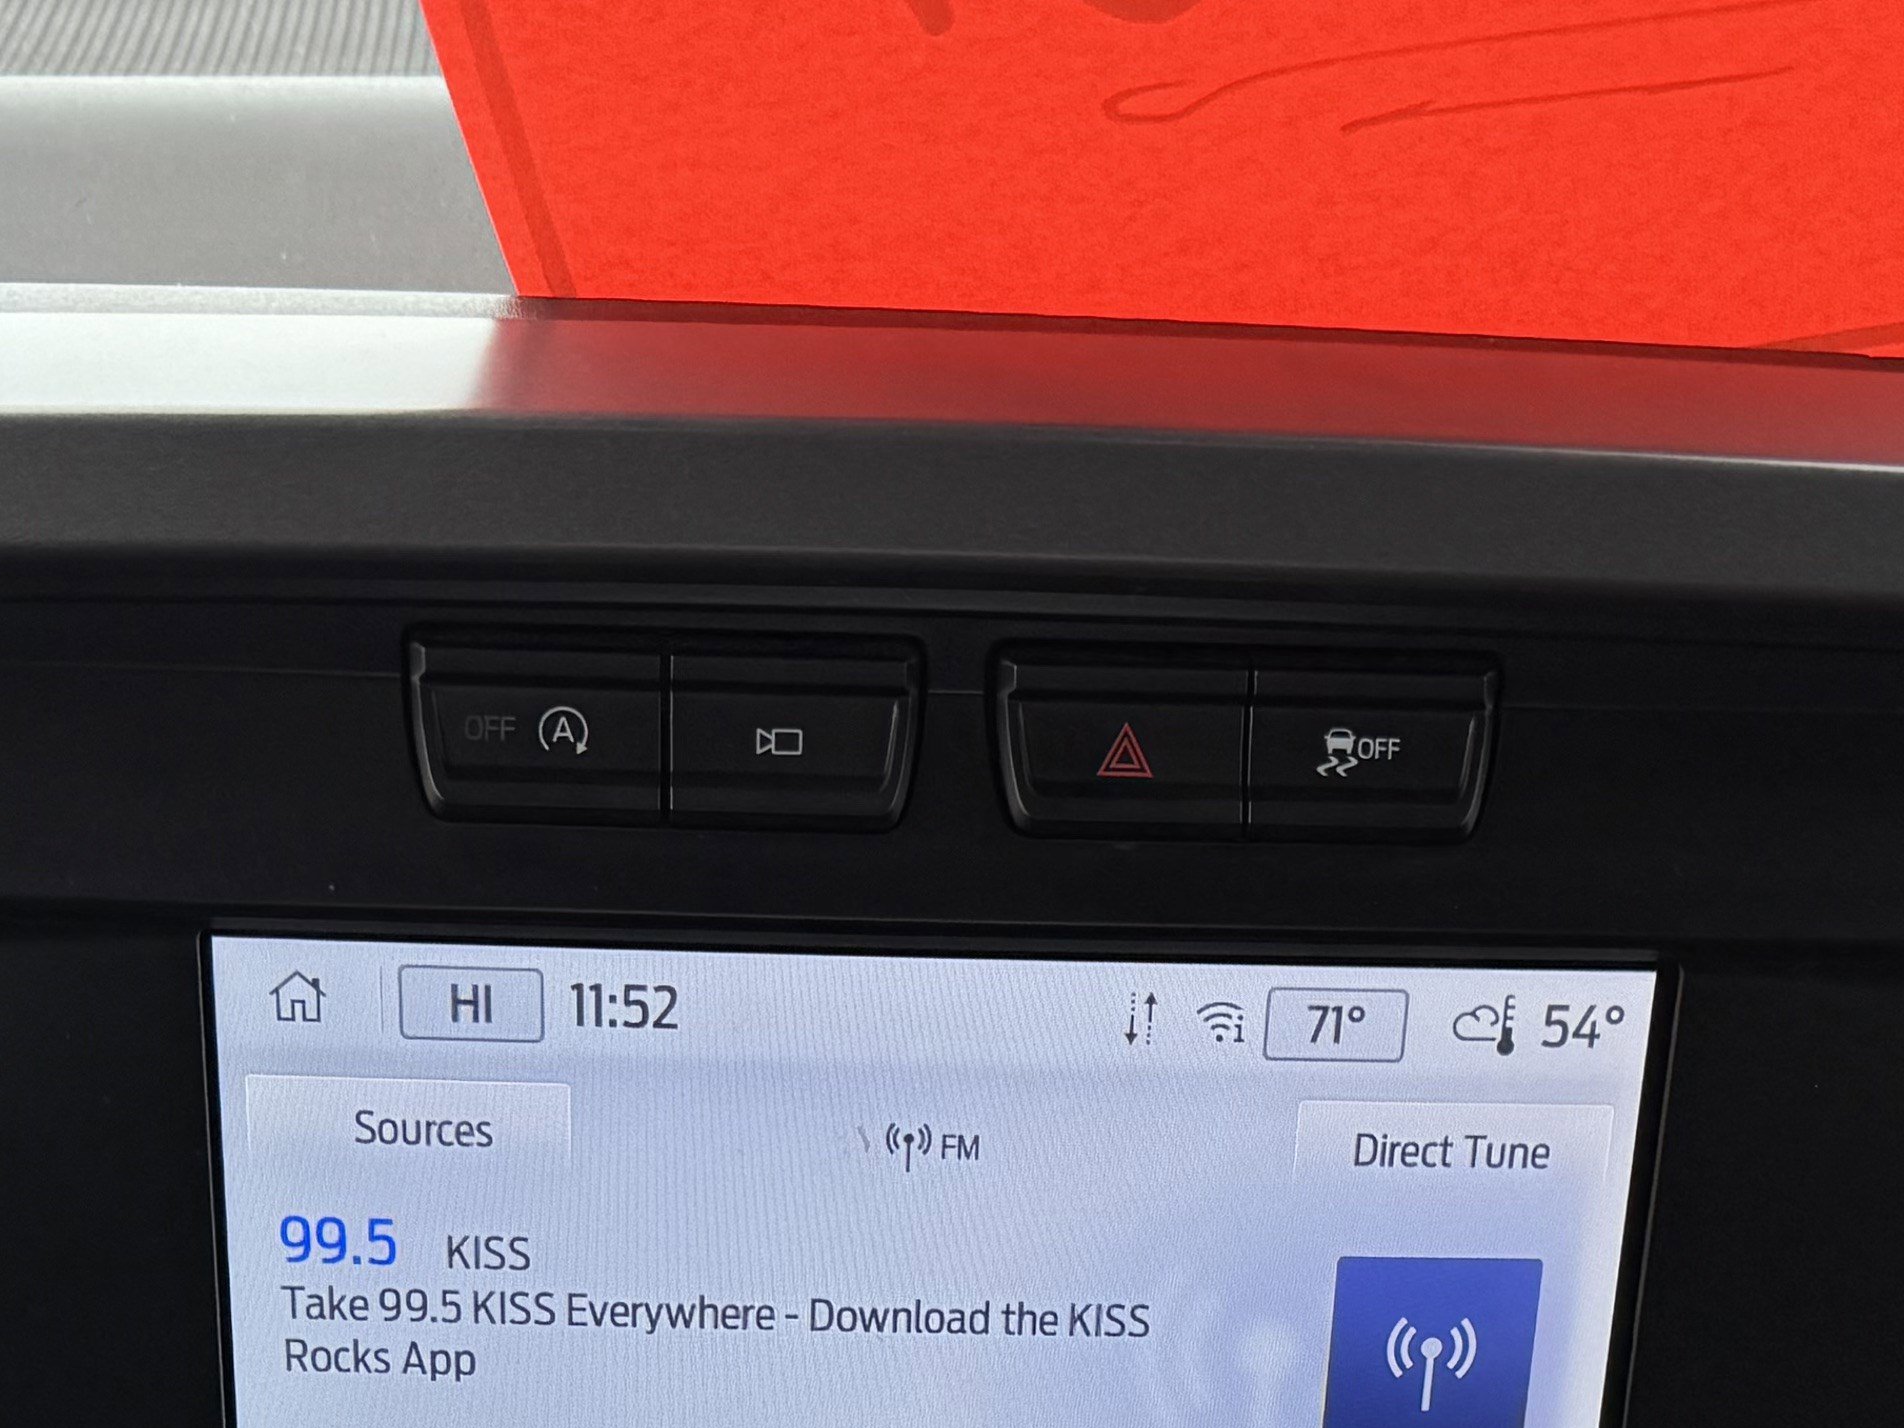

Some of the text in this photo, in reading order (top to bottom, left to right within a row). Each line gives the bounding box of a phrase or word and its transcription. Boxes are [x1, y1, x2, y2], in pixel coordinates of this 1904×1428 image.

[464, 714, 517, 742] OFF
[1358, 737, 1401, 761] OFF
[450, 981, 680, 1032] HI 11:52
[1306, 1003, 1626, 1050] 71° 54°
[354, 1108, 494, 1149] Sources
[941, 1134, 981, 1161] FM
[1353, 1131, 1552, 1171] Direct Tune
[278, 1214, 532, 1272] 99.5 KISS
[281, 1284, 370, 1324] Take
[378, 1287, 463, 1325] 99.5
[472, 1290, 557, 1327] KISS
[566, 1292, 776, 1336] Everywhere
[809, 1296, 991, 1336] Download
[1000, 1300, 1060, 1337] the
[1068, 1302, 1151, 1339] KISS
[284, 1337, 477, 1383] Rocks App
